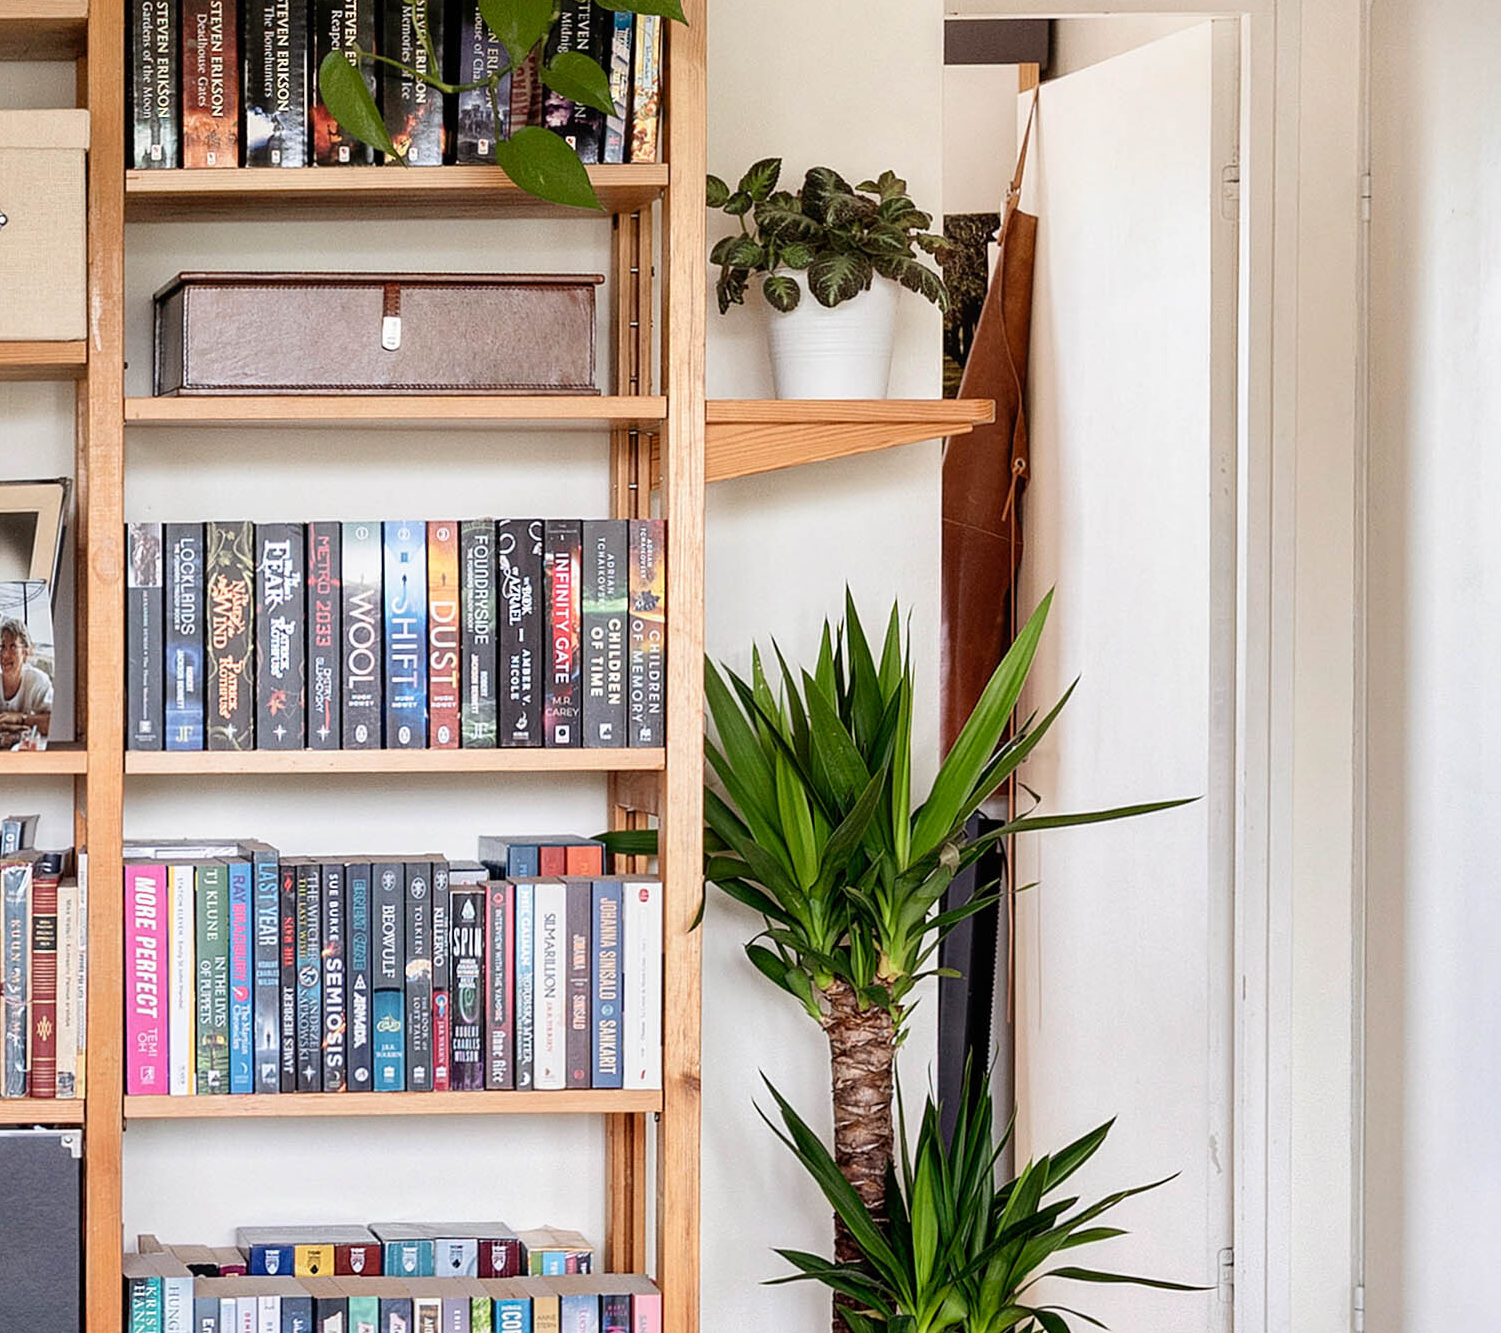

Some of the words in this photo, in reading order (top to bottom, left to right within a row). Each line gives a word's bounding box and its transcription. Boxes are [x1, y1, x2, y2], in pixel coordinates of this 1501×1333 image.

[156, 2, 169, 53] STEVEN
[209, 2, 222, 53] STEVEN
[157, 58, 170, 118] ERIKSON
[211, 58, 224, 117] ERIKSON
[276, 52, 289, 112] ERIKSON
[180, 538, 194, 635] LOCKLANDS
[317, 536, 329, 595] METRO
[474, 536, 488, 644] FOUNDRYSIDE
[554, 553, 569, 634] INFINITY
[316, 602, 331, 647] 2033
[349, 590, 375, 689] WOOL
[430, 601, 456, 688] DUST
[590, 627, 603, 647] OF
[554, 638, 569, 683] GATE
[590, 651, 603, 697] TIME
[607, 618, 621, 706] CHILDREN
[648, 630, 659, 714] CHILDREN
[134, 876, 157, 930] MORE
[258, 863, 279, 901] LAST
[328, 874, 339, 896] SUE
[206, 891, 217, 941] KLUNE
[258, 906, 278, 946] YEAR
[328, 901, 339, 941] BURKE
[382, 905, 395, 978] BEOWULF
[453, 928, 482, 956] SPIN
[599, 898, 615, 947] JOHANNA
[135, 935, 157, 1019] PERFECT
[326, 958, 343, 1067] SEMIOSIS
[599, 1021, 616, 1074] SANKARIT
